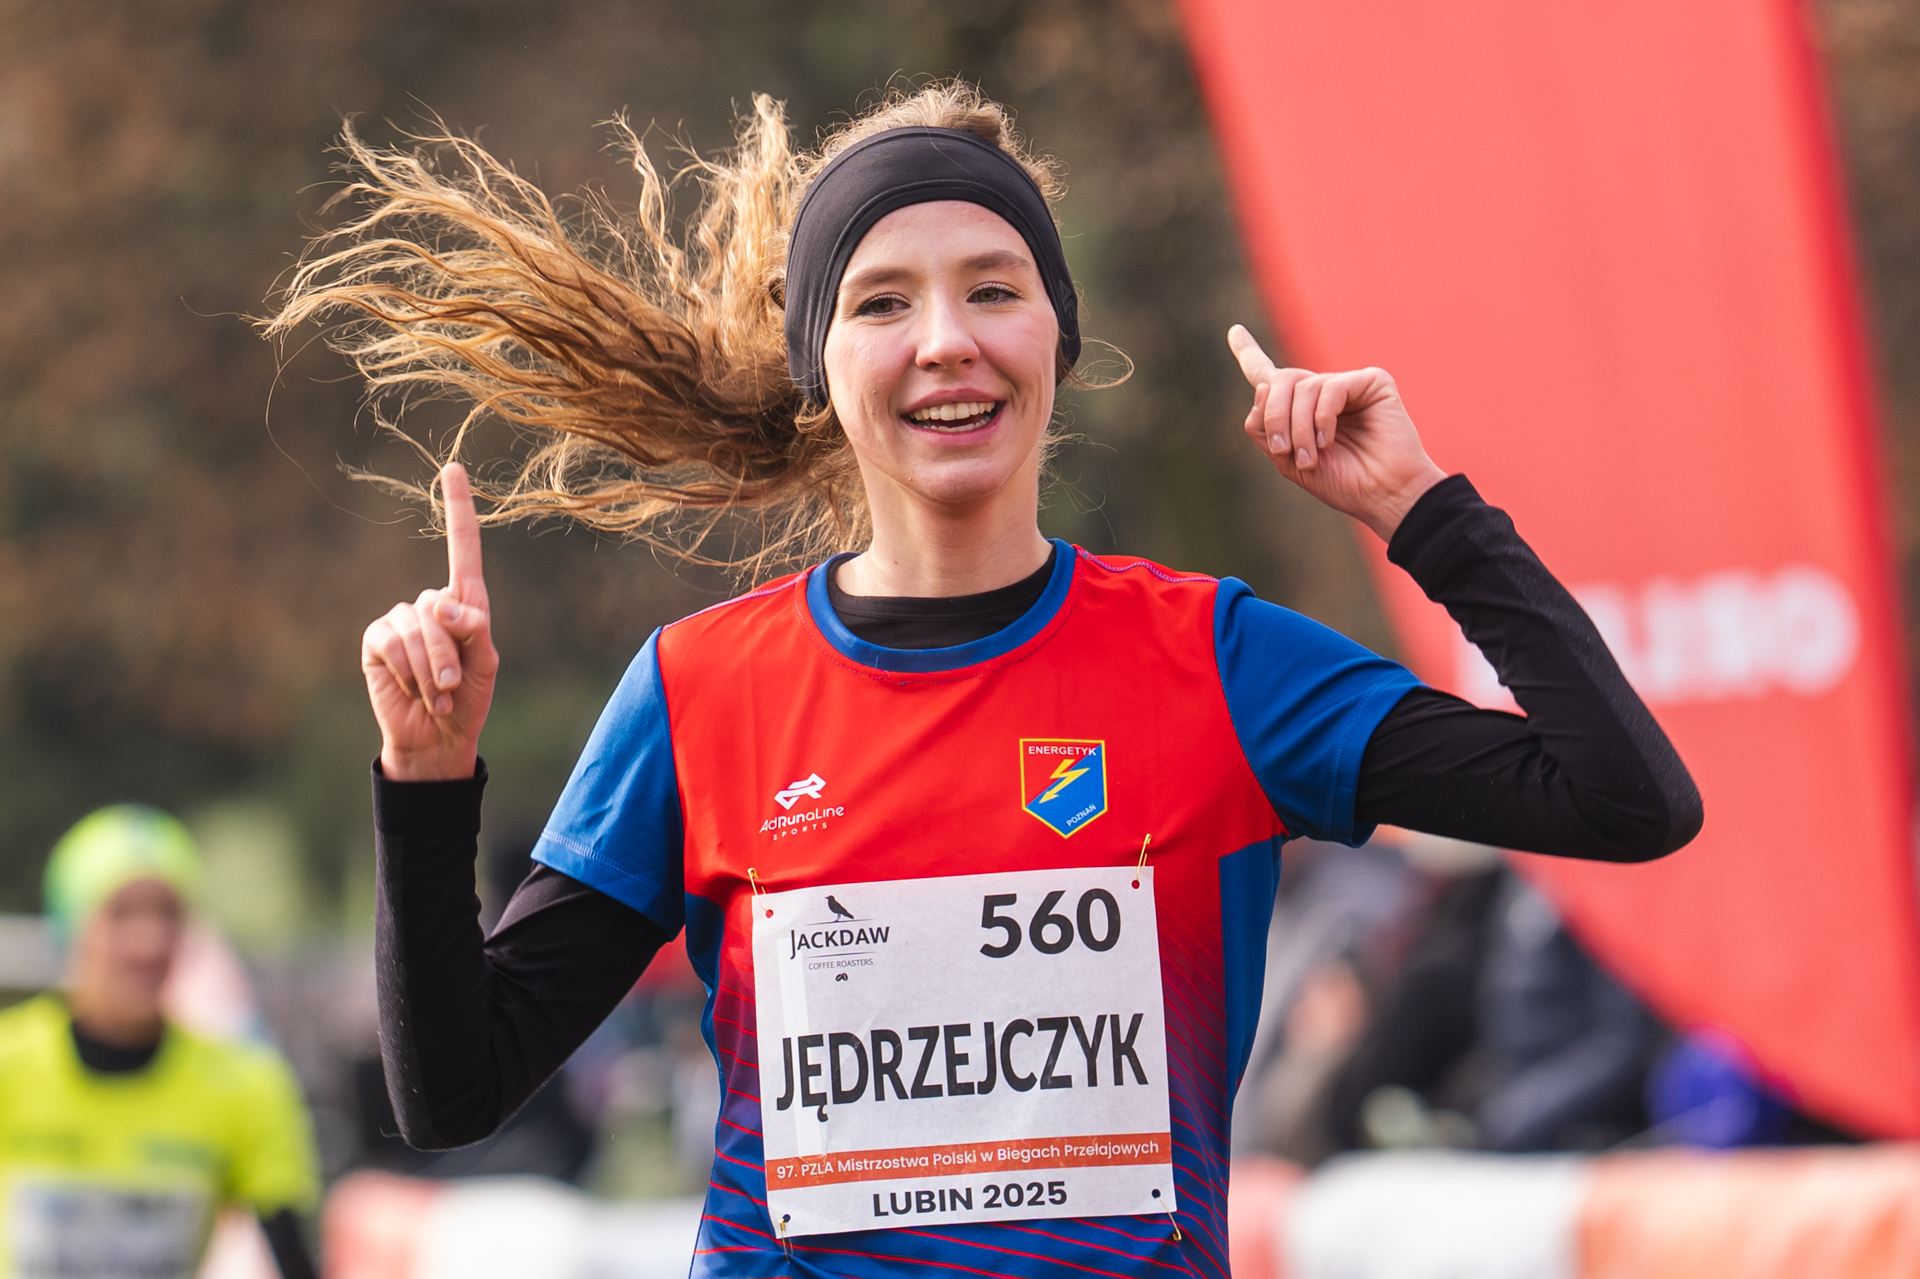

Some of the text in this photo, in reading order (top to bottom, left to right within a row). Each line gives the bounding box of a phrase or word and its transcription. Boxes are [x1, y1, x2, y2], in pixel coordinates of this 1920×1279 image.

[1028, 745, 1097, 756] ENERGETYK
[773, 822, 828, 841] SPORTS
[1066, 803, 1097, 827] POZNAŃ
[979, 888, 1122, 959] 560
[790, 926, 890, 960] JACKDAW
[808, 958, 874, 971] COFFEE ROASTERS
[776, 1013, 1149, 1123] JĘDRZEJCZYK
[776, 1139, 1159, 1179] 97. PZLA Mistrzostwa Polski w Biegach Przełajowych
[873, 1180, 1068, 1217] LUBIN 2025
